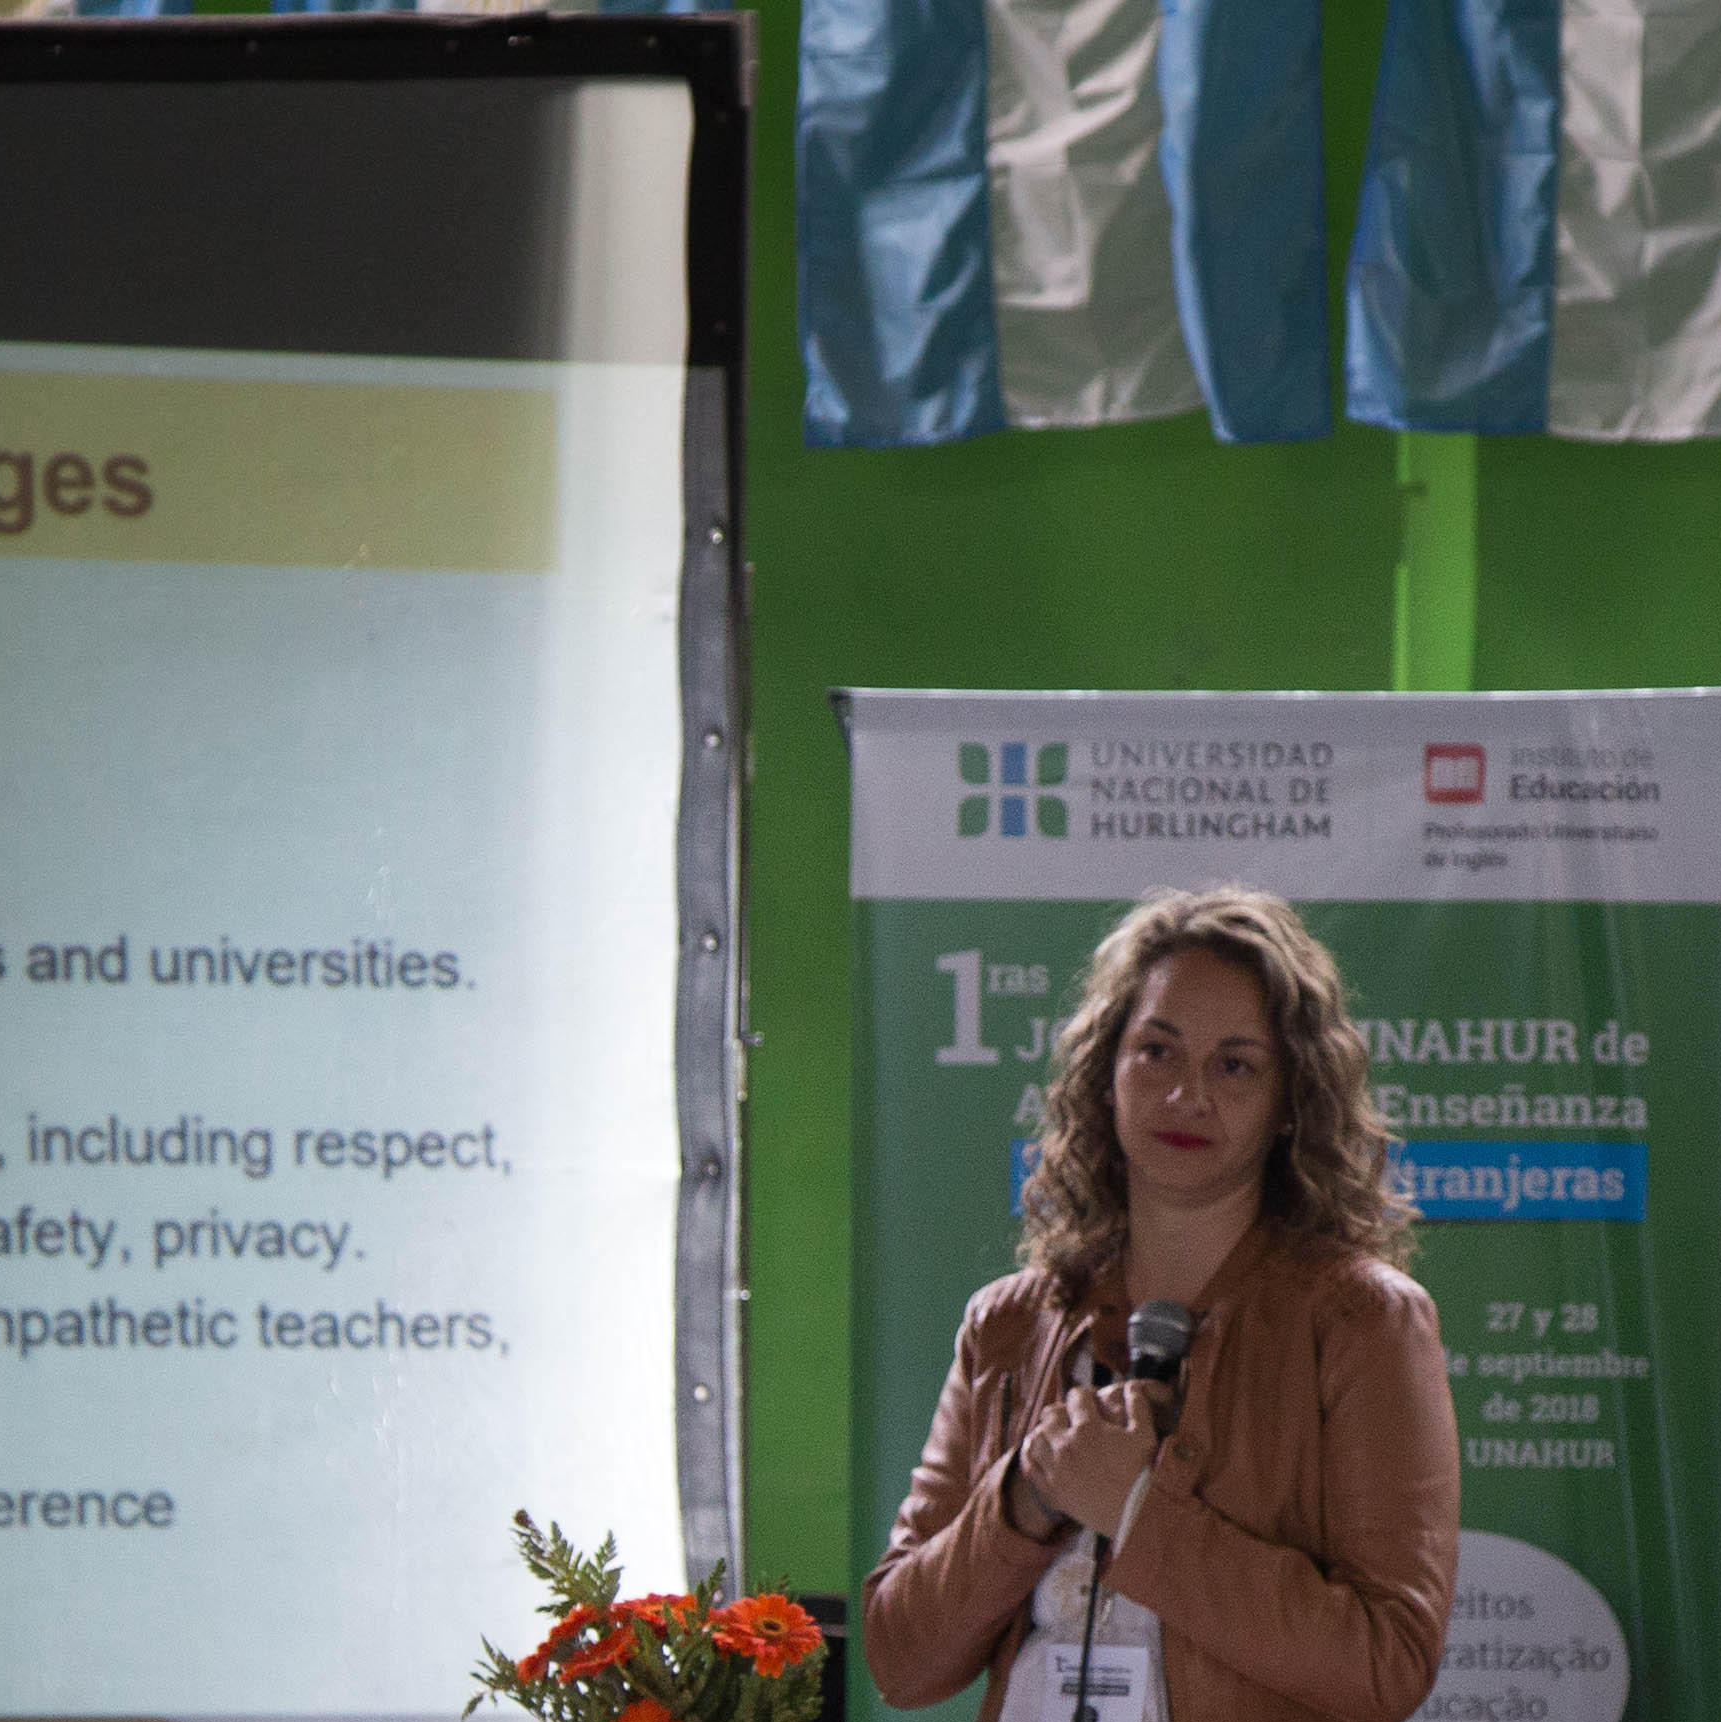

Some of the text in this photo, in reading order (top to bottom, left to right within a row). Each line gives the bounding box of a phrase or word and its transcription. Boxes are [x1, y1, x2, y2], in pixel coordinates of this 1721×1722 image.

[1090, 741, 1332, 767] UNIVERSIDAD
[1090, 777, 1330, 804] NACIONAL DE
[1510, 772, 1660, 802] Educación
[1090, 813, 1332, 841] HURLINGHAM
[24, 934, 131, 986] and
[148, 941, 477, 992] universities.
[1593, 1020, 1649, 1065] de
[1377, 1084, 1648, 1130] Enseñanza
[26, 1115, 275, 1181] including
[292, 1124, 514, 1181] respect,
[151, 1218, 366, 1272] privacy.
[254, 1300, 512, 1355] teachers,
[1486, 1302, 1599, 1337] 27 y 28
[1478, 1347, 1650, 1384] septiembre
[1482, 1393, 1600, 1423] de 2018
[1468, 1438, 1616, 1469] UNAHUR
[1441, 1635, 1612, 1679] ratização
